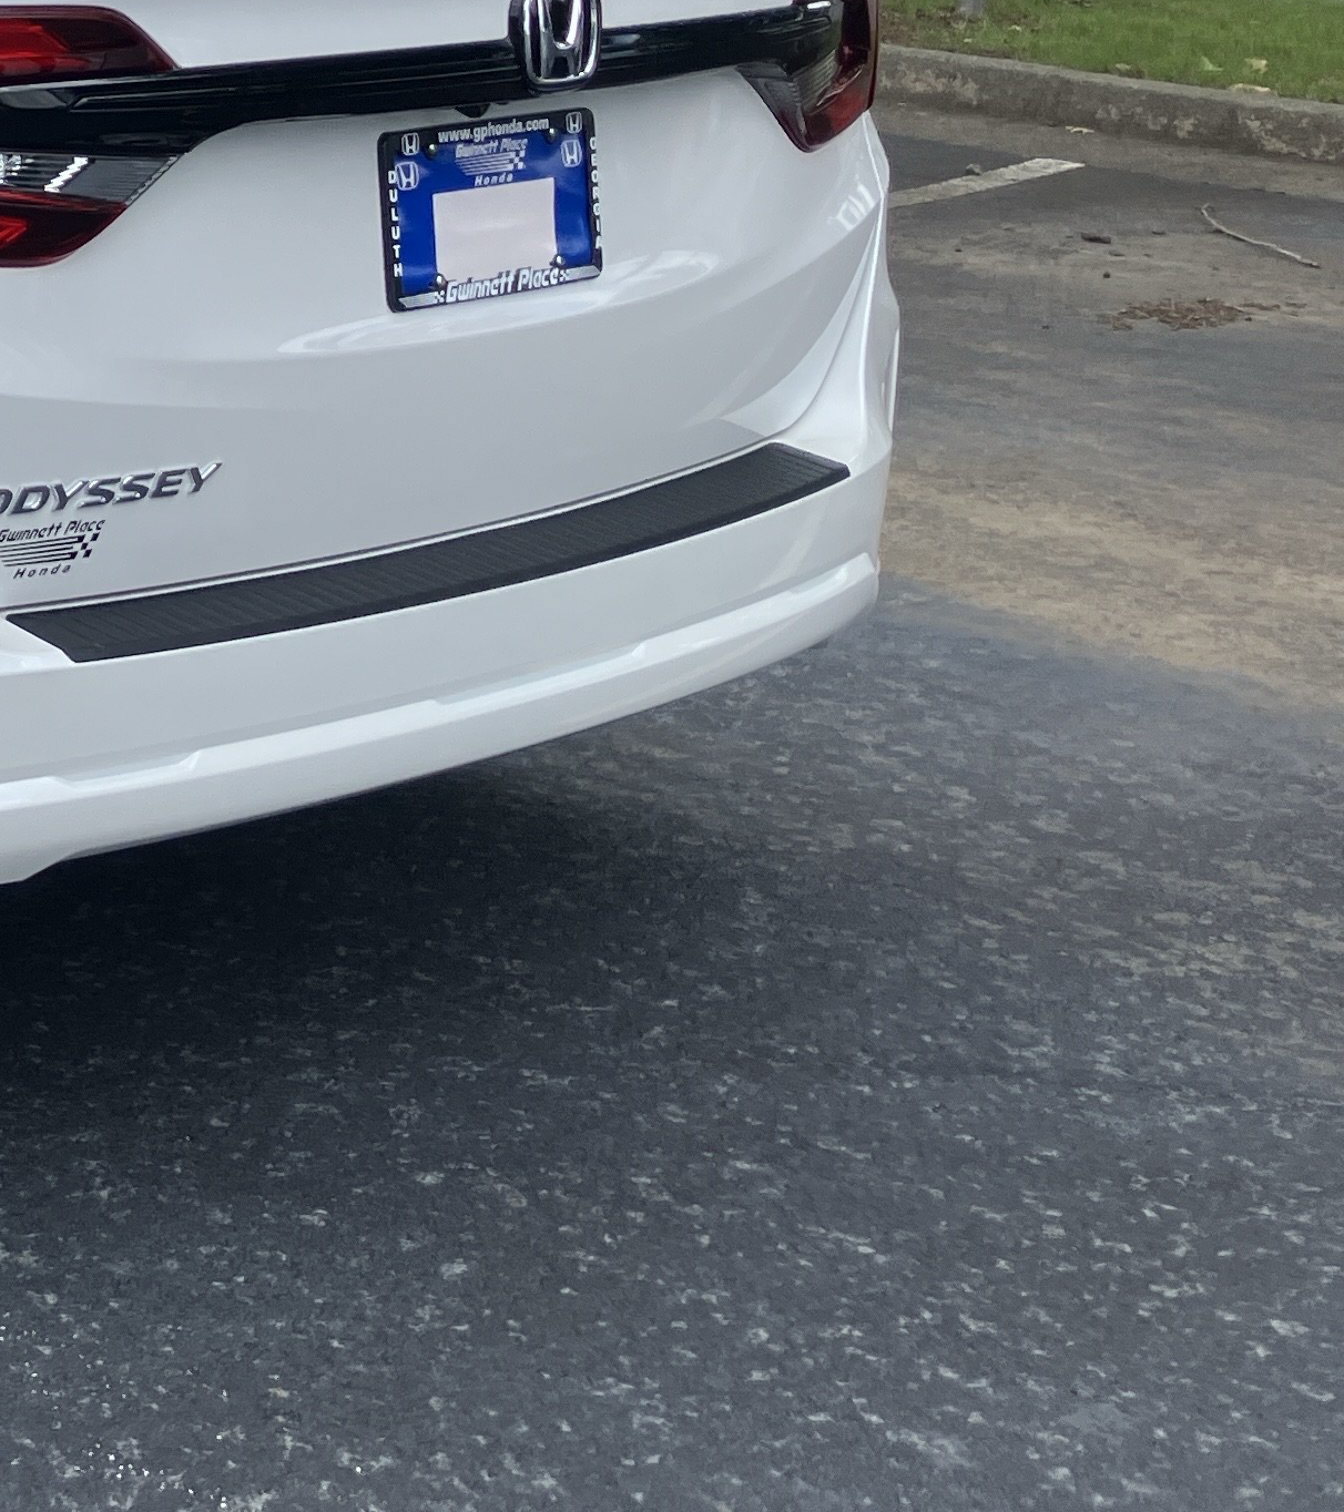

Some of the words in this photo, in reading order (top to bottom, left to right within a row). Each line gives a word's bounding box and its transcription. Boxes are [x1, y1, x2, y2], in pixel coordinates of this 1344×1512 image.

[437, 118, 550, 143] www.gphonda.com
[474, 172, 514, 187] Honda
[388, 170, 403, 277] DULUTH
[445, 270, 514, 303] Gwinnett
[517, 266, 559, 292] Place
[64, 519, 106, 535] Place
[12, 563, 72, 580] Honda
